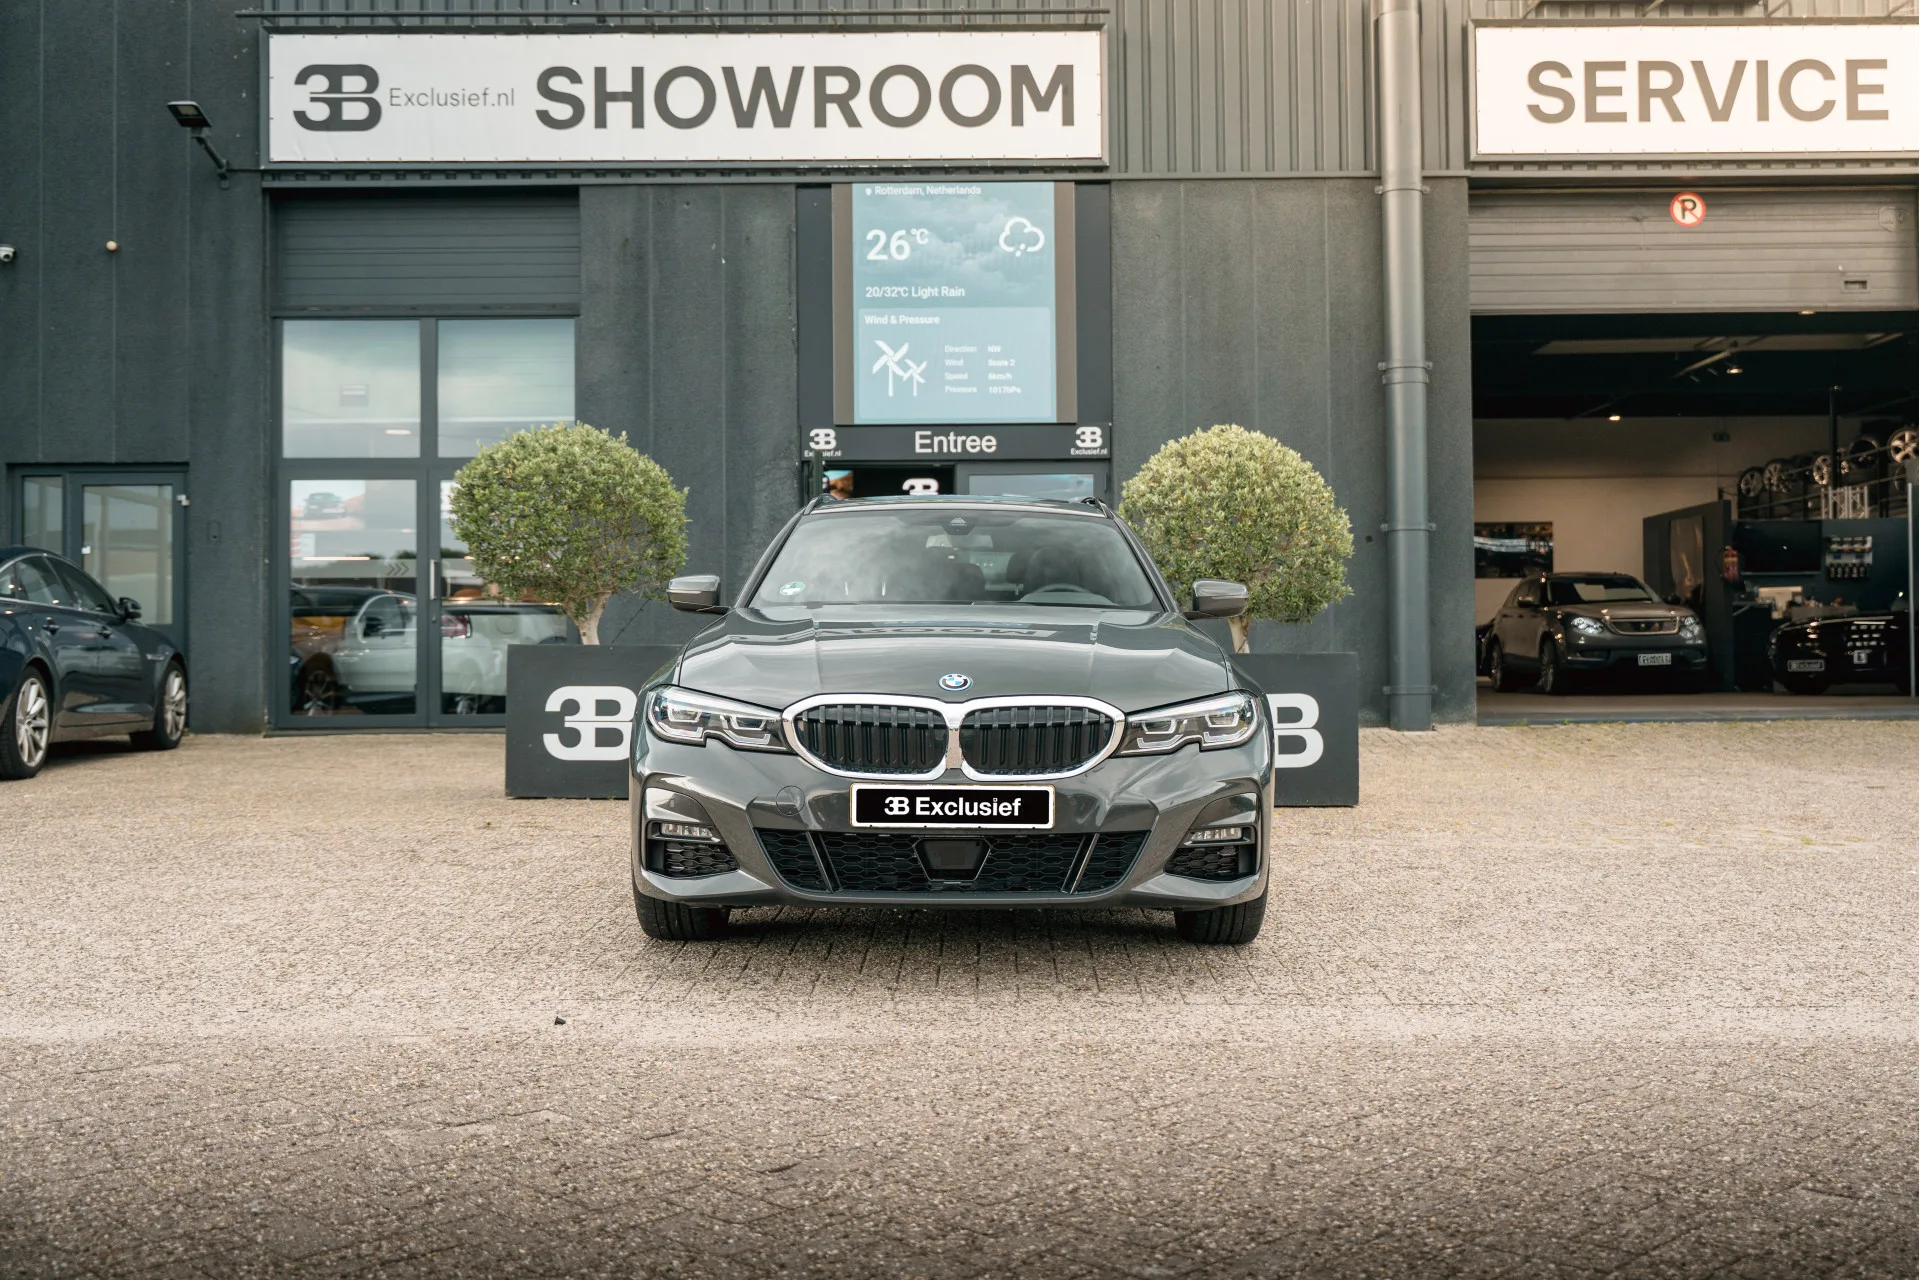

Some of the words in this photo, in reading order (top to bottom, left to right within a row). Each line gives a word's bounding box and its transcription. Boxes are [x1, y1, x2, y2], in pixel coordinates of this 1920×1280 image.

[389, 88, 515, 107] Exclusief.nl
[535, 64, 1075, 130] SHOWROOM
[1526, 58, 1889, 124] SERVICE
[874, 186, 925, 196] Rotterdam,
[926, 186, 982, 196] Netherlands
[1681, 198, 1697, 220] P
[911, 286, 939, 299] Light
[941, 286, 966, 297] Rain
[864, 315, 888, 325] Wind
[890, 315, 897, 325] &
[899, 315, 940, 325] Pressure
[915, 431, 997, 454] Entree
[1070, 447, 1108, 456] Exclusief.nl
[915, 797, 1021, 817] Exclusief
